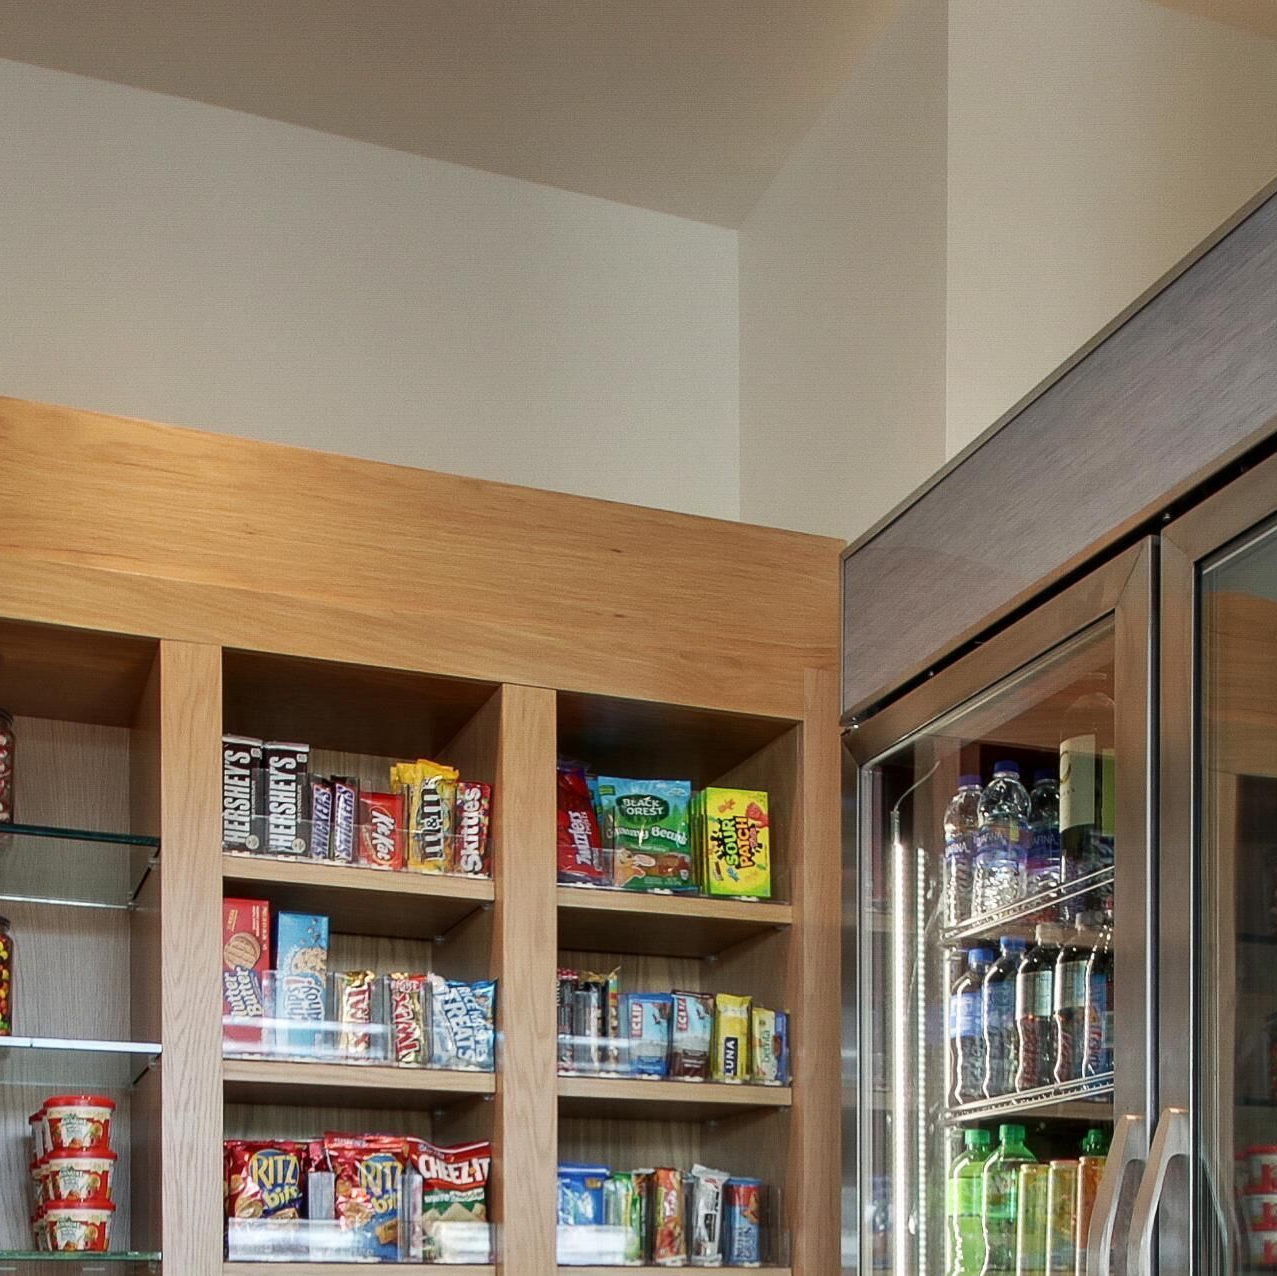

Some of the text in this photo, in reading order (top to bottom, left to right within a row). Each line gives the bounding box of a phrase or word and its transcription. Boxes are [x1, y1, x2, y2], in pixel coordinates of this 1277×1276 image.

[224, 749, 251, 843] HERSHEY'S
[269, 755, 297, 847] HERSHEY'S
[623, 797, 660, 807] BLACK
[624, 807, 664, 816] OREST
[312, 785, 332, 858] SNICKERS
[724, 820, 736, 867] SOUR
[735, 816, 749, 869] PATCH
[443, 987, 476, 1060] TREATS
[724, 1040, 735, 1077] LUNA
[251, 1154, 299, 1192] RITZ
[418, 1154, 491, 1185] CHEEZ-IT
